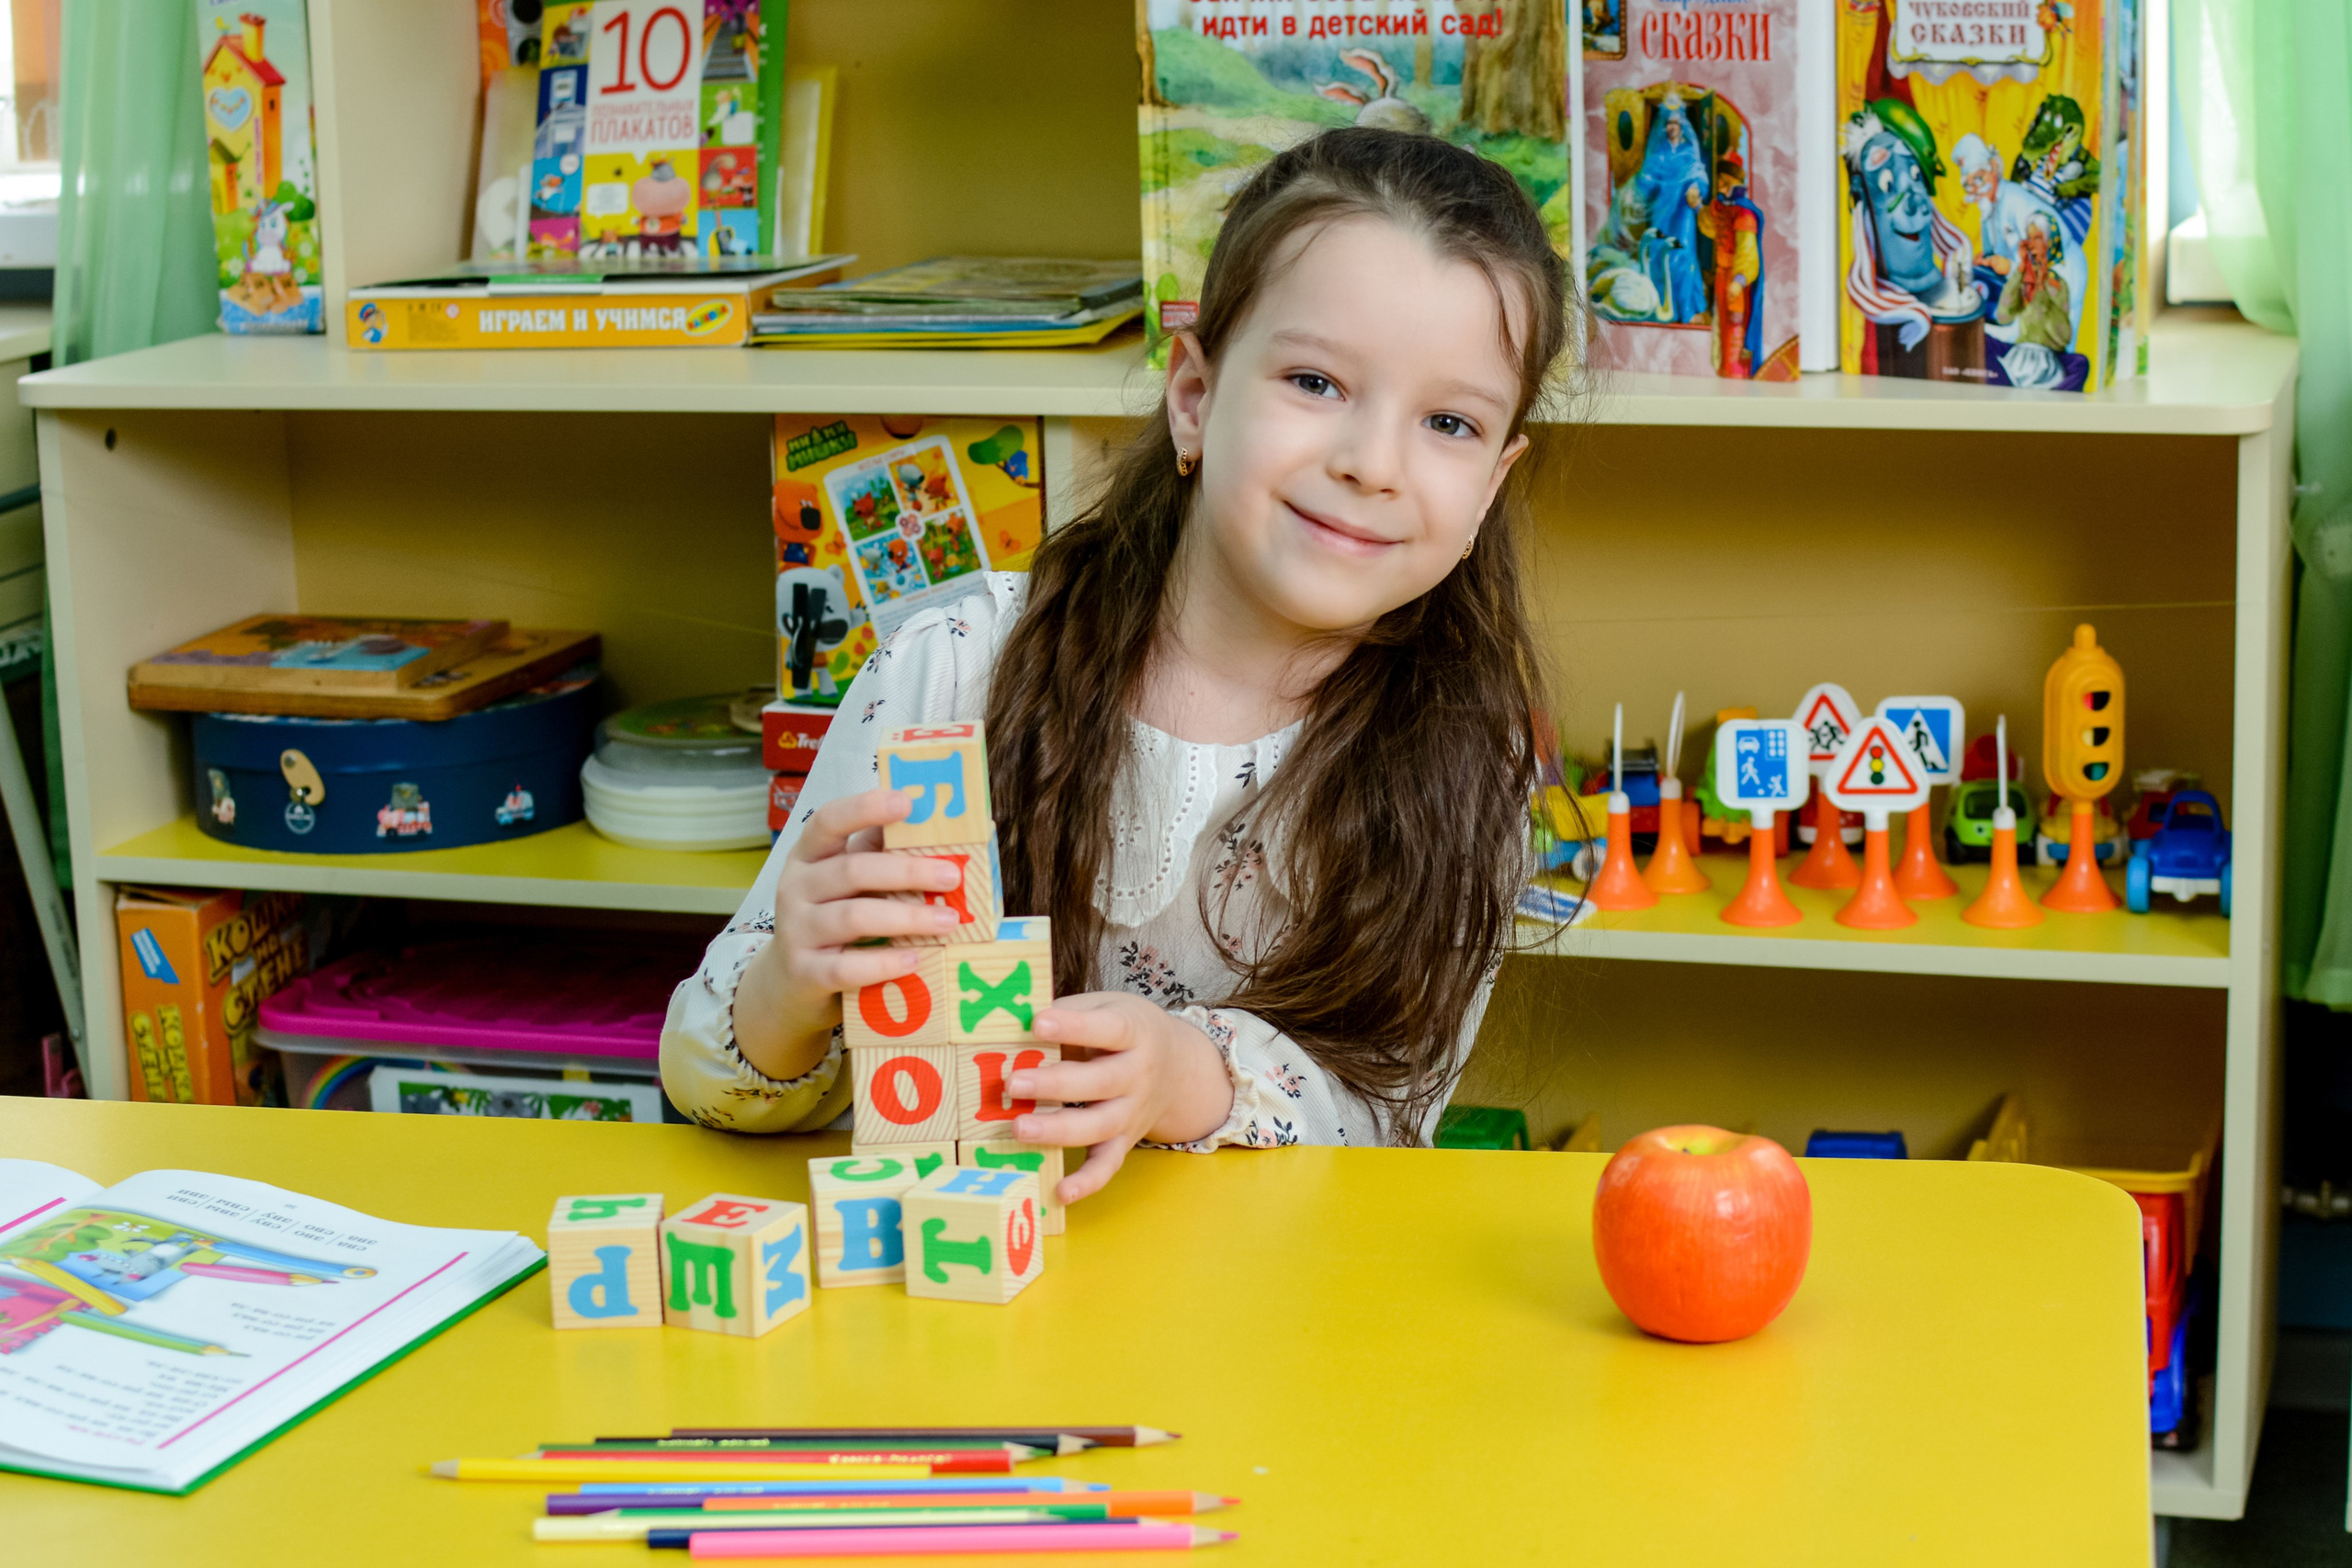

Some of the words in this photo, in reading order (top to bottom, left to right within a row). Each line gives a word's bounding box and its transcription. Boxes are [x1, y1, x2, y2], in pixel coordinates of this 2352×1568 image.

[1203, 16, 1267, 39] идти
[1282, 16, 1296, 36] в
[1308, 8, 1428, 39] детский
[1441, 7, 1502, 39] сад!
[1641, 10, 1770, 62] сказки
[1911, 22, 2027, 46] СКАЗКИ
[600, 6, 691, 95] 10
[591, 113, 695, 144] ПЛАКАТОВ
[479, 309, 566, 333] ИГРАЕМ
[572, 309, 588, 332] И
[594, 307, 686, 331] УЧИМСЯ
[958, 961, 1034, 1033] Х
[870, 1055, 943, 1125] О
[834, 1197, 904, 1271] В
